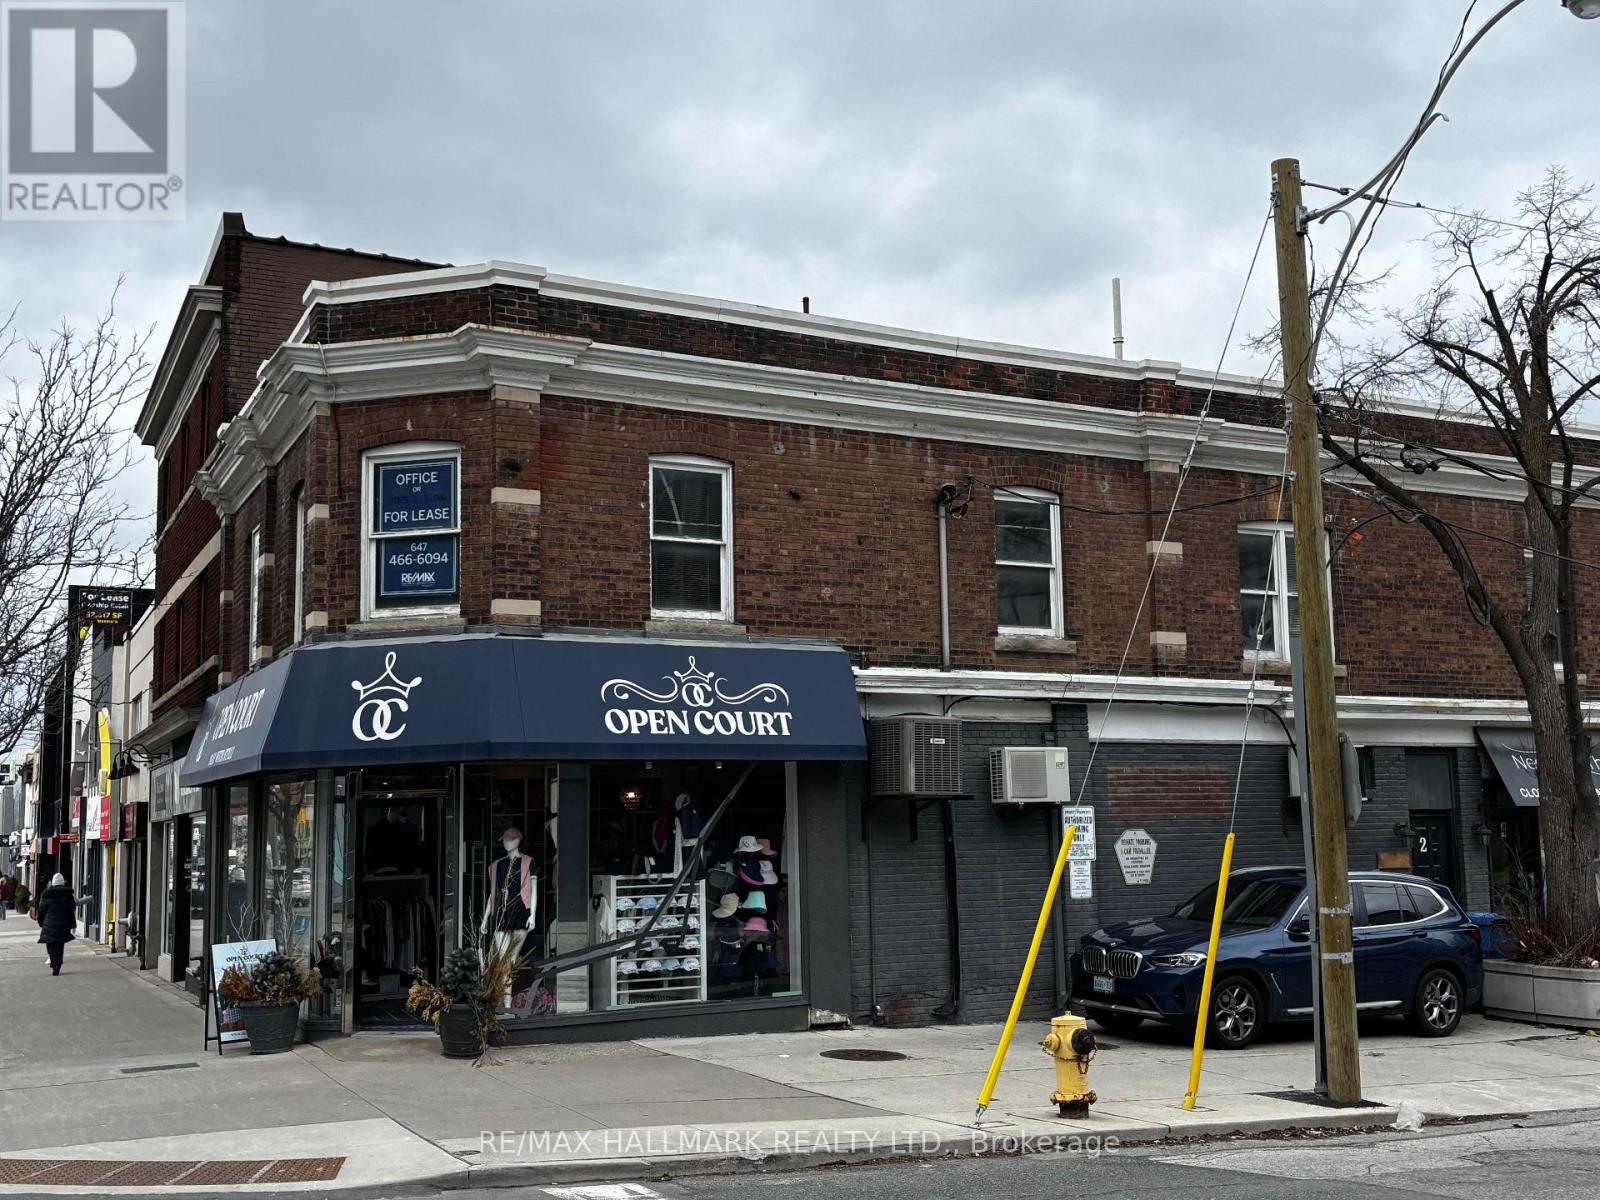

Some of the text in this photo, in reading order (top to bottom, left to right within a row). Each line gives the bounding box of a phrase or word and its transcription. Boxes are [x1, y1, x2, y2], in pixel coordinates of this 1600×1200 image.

[395, 471, 439, 485] OFFICE
[384, 508, 450, 523] FOR LEASE
[410, 542, 428, 552] 647
[388, 552, 449, 566] 466-6094
[604, 708, 793, 736] OPEN COURT
[1419, 837, 1428, 853] 2
